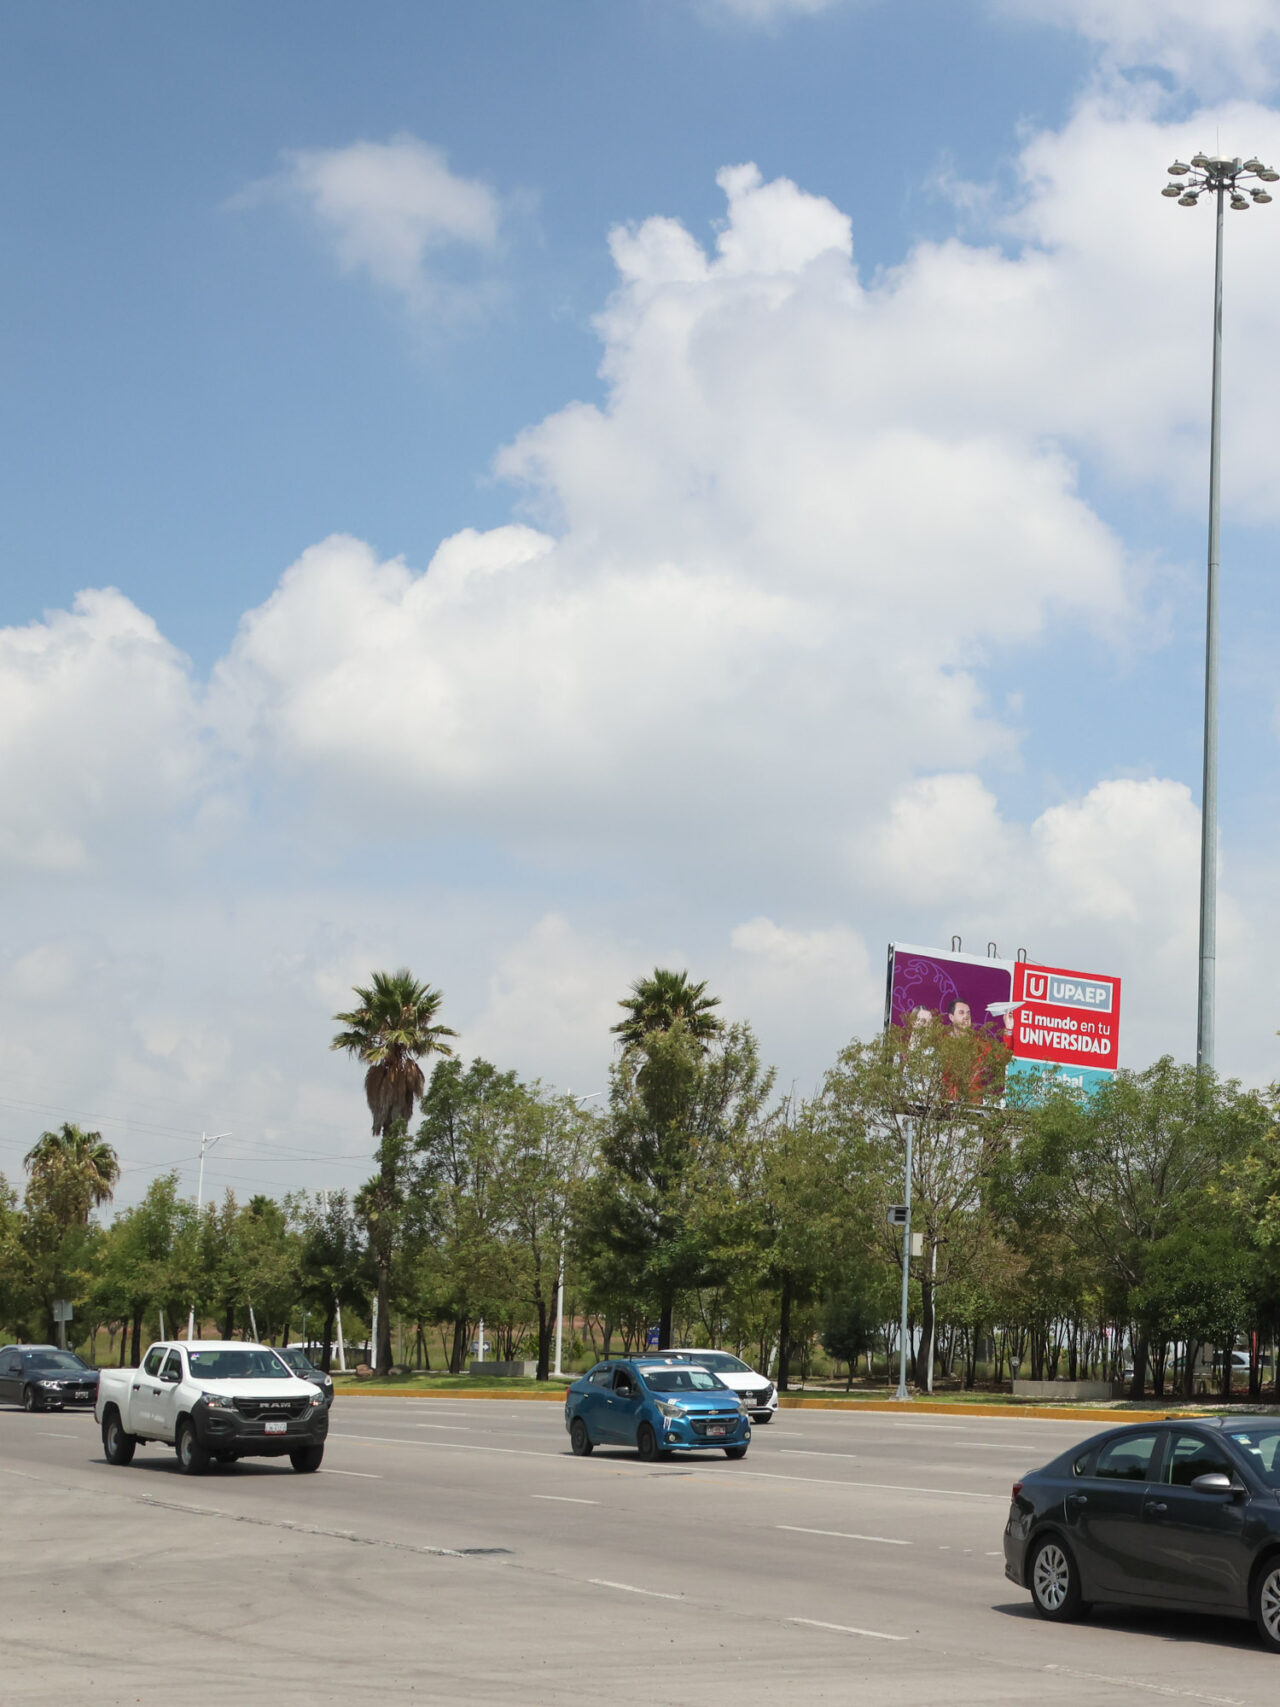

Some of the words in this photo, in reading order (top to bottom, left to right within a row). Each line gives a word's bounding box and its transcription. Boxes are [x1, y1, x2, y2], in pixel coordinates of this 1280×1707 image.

[1053, 982, 1107, 1004] UPAEP
[1020, 1009, 1033, 1025] El
[1034, 1014, 1078, 1031] mundo
[1080, 1021, 1096, 1034] en
[1098, 1021, 1111, 1036] tu
[1019, 1026, 1112, 1055] UNIVERSIDAD
